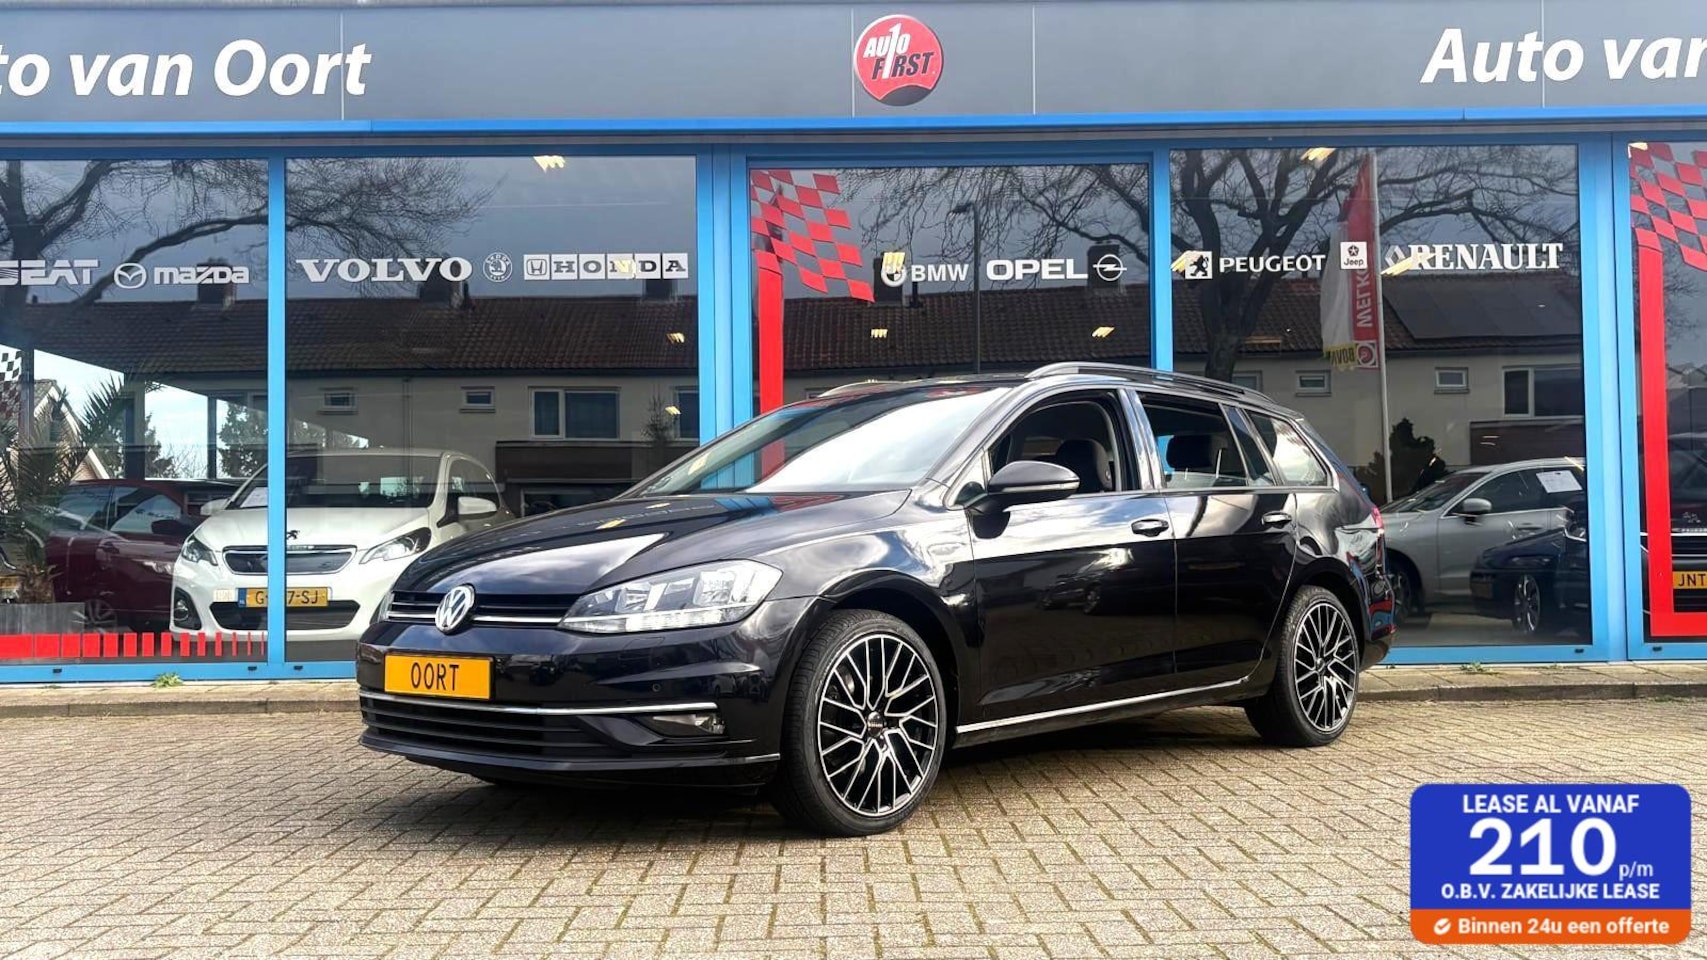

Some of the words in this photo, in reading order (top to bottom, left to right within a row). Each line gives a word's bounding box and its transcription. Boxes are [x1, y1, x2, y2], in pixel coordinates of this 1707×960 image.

[70, 53, 193, 96] van
[214, 39, 372, 97] Oort
[1420, 28, 1584, 84] Auto
[1219, 254, 1327, 273] PEUGEOT
[1343, 257, 1364, 268] Jeep
[1408, 242, 1563, 271] RENAULT
[153, 265, 249, 285] mazda
[296, 257, 473, 283] VOLVO
[911, 264, 969, 282] BMW
[986, 258, 1089, 281] OPEL
[410, 661, 460, 692] OORT
